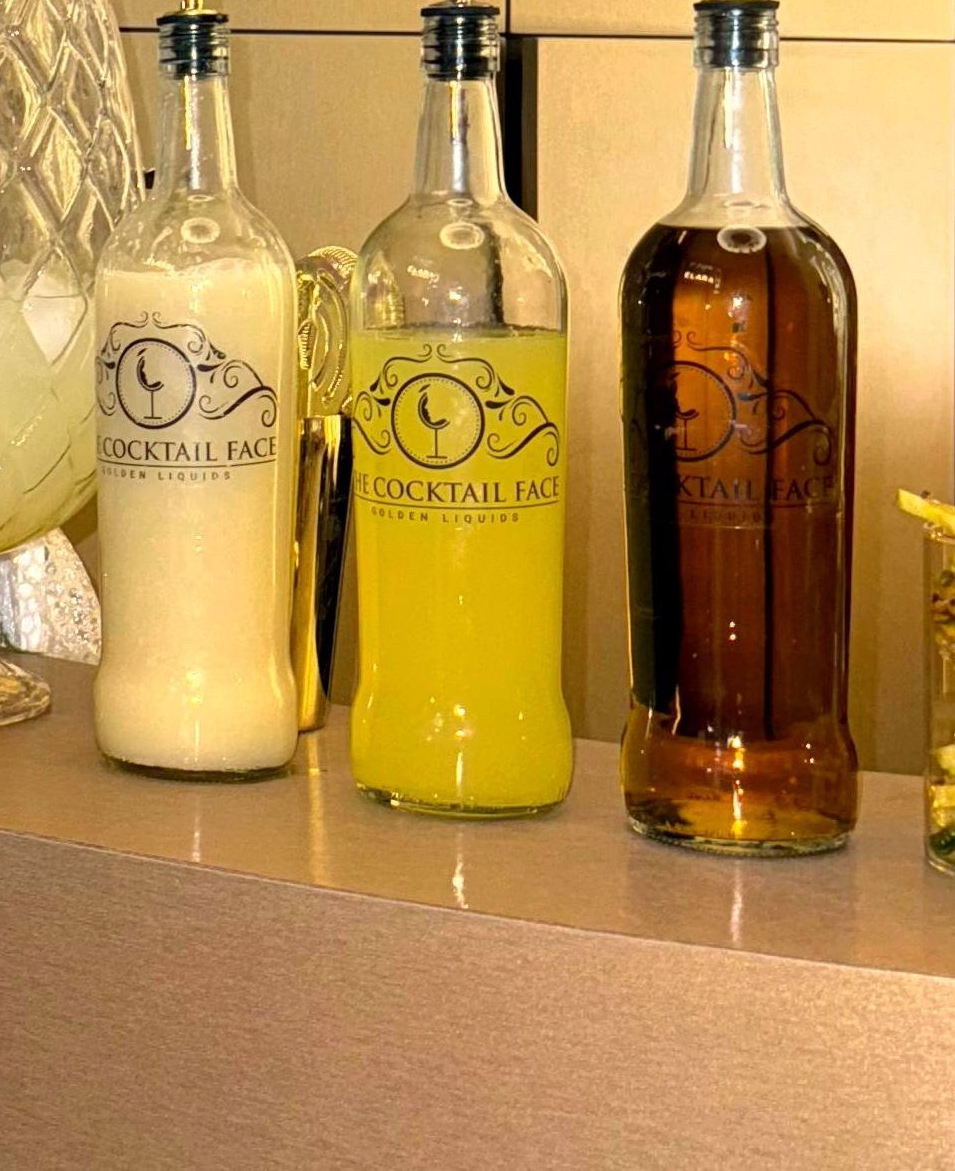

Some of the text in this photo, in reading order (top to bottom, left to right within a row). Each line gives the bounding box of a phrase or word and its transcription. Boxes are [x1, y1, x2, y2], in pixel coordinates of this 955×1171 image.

[103, 436, 218, 462] COCKTAIL
[227, 435, 277, 461] FACE
[157, 471, 231, 482] LIQUIDS
[373, 476, 507, 503] COCKTAIL
[516, 475, 559, 502] FACE
[678, 475, 760, 501] KTAIL
[371, 505, 519, 524] GOLDEN LIQUIDS
